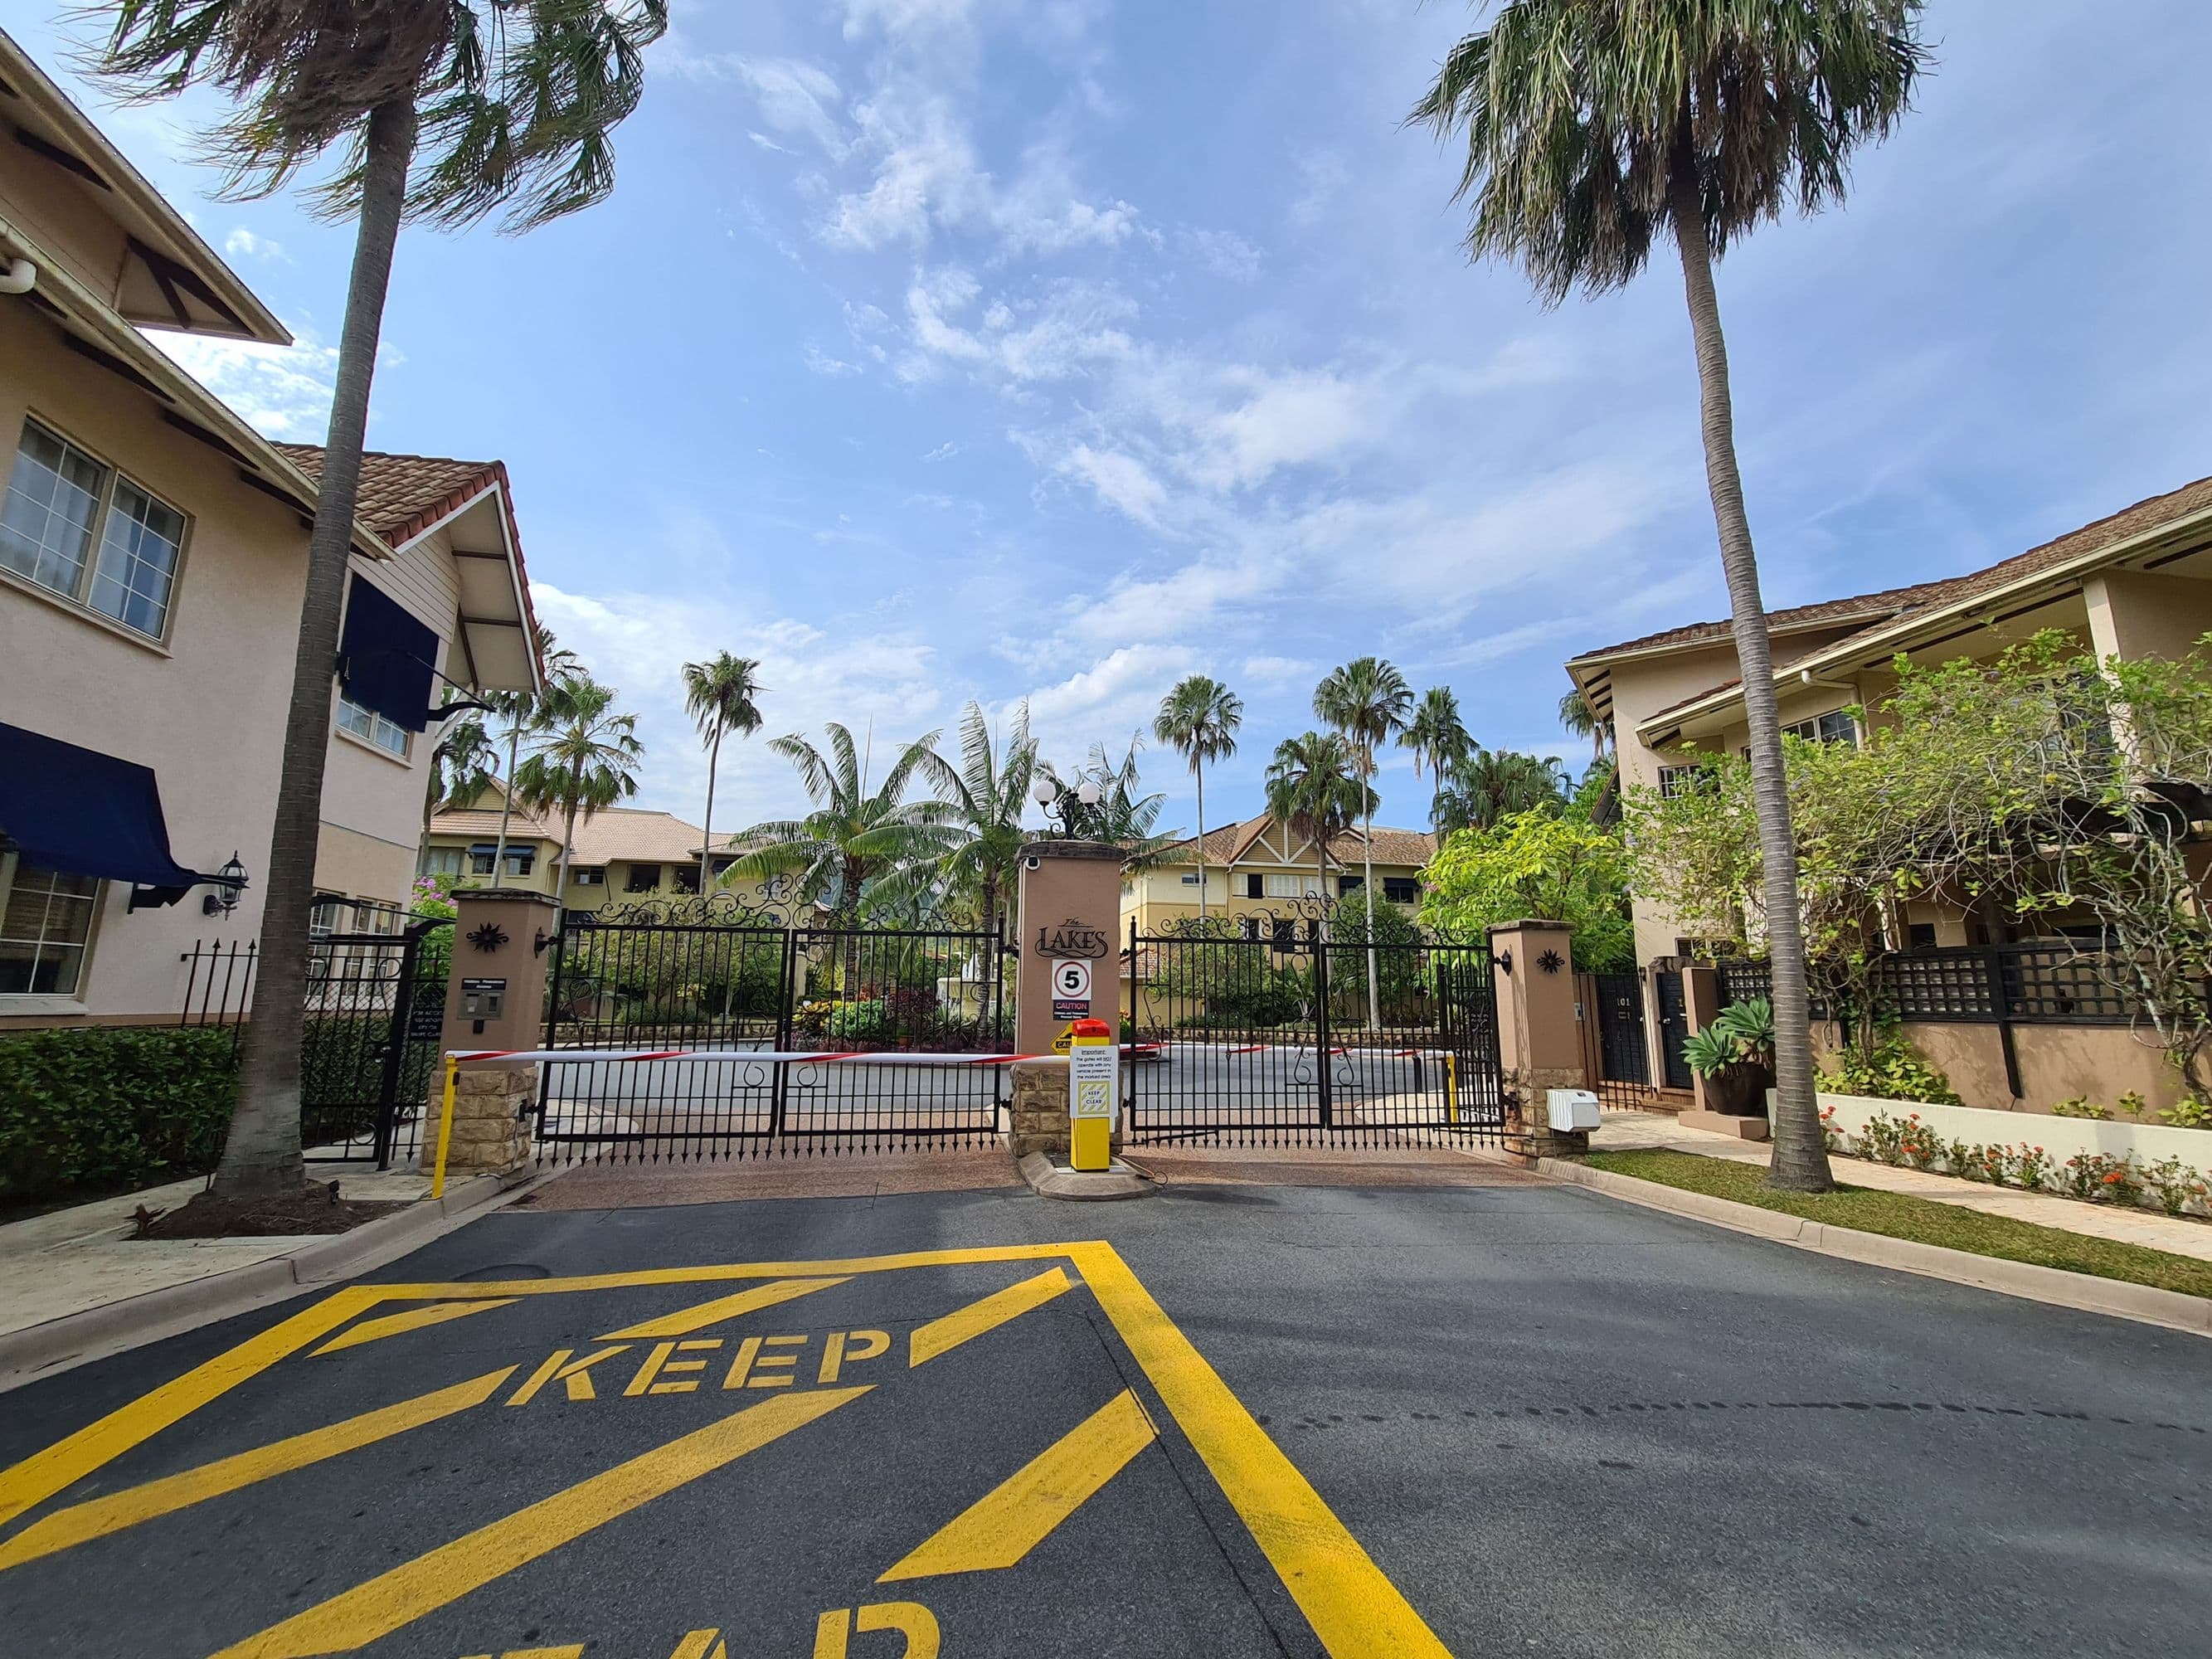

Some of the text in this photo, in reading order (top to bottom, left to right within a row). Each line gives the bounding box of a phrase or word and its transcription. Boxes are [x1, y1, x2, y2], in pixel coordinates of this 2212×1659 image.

[1063, 917, 1084, 927] The
[1036, 927, 1108, 955] LAKES
[1064, 971, 1080, 990] 5
[1056, 1002, 1087, 1010] CAUTION
[1617, 998, 1631, 1006] 101
[504, 1330, 891, 1407] KEEP
